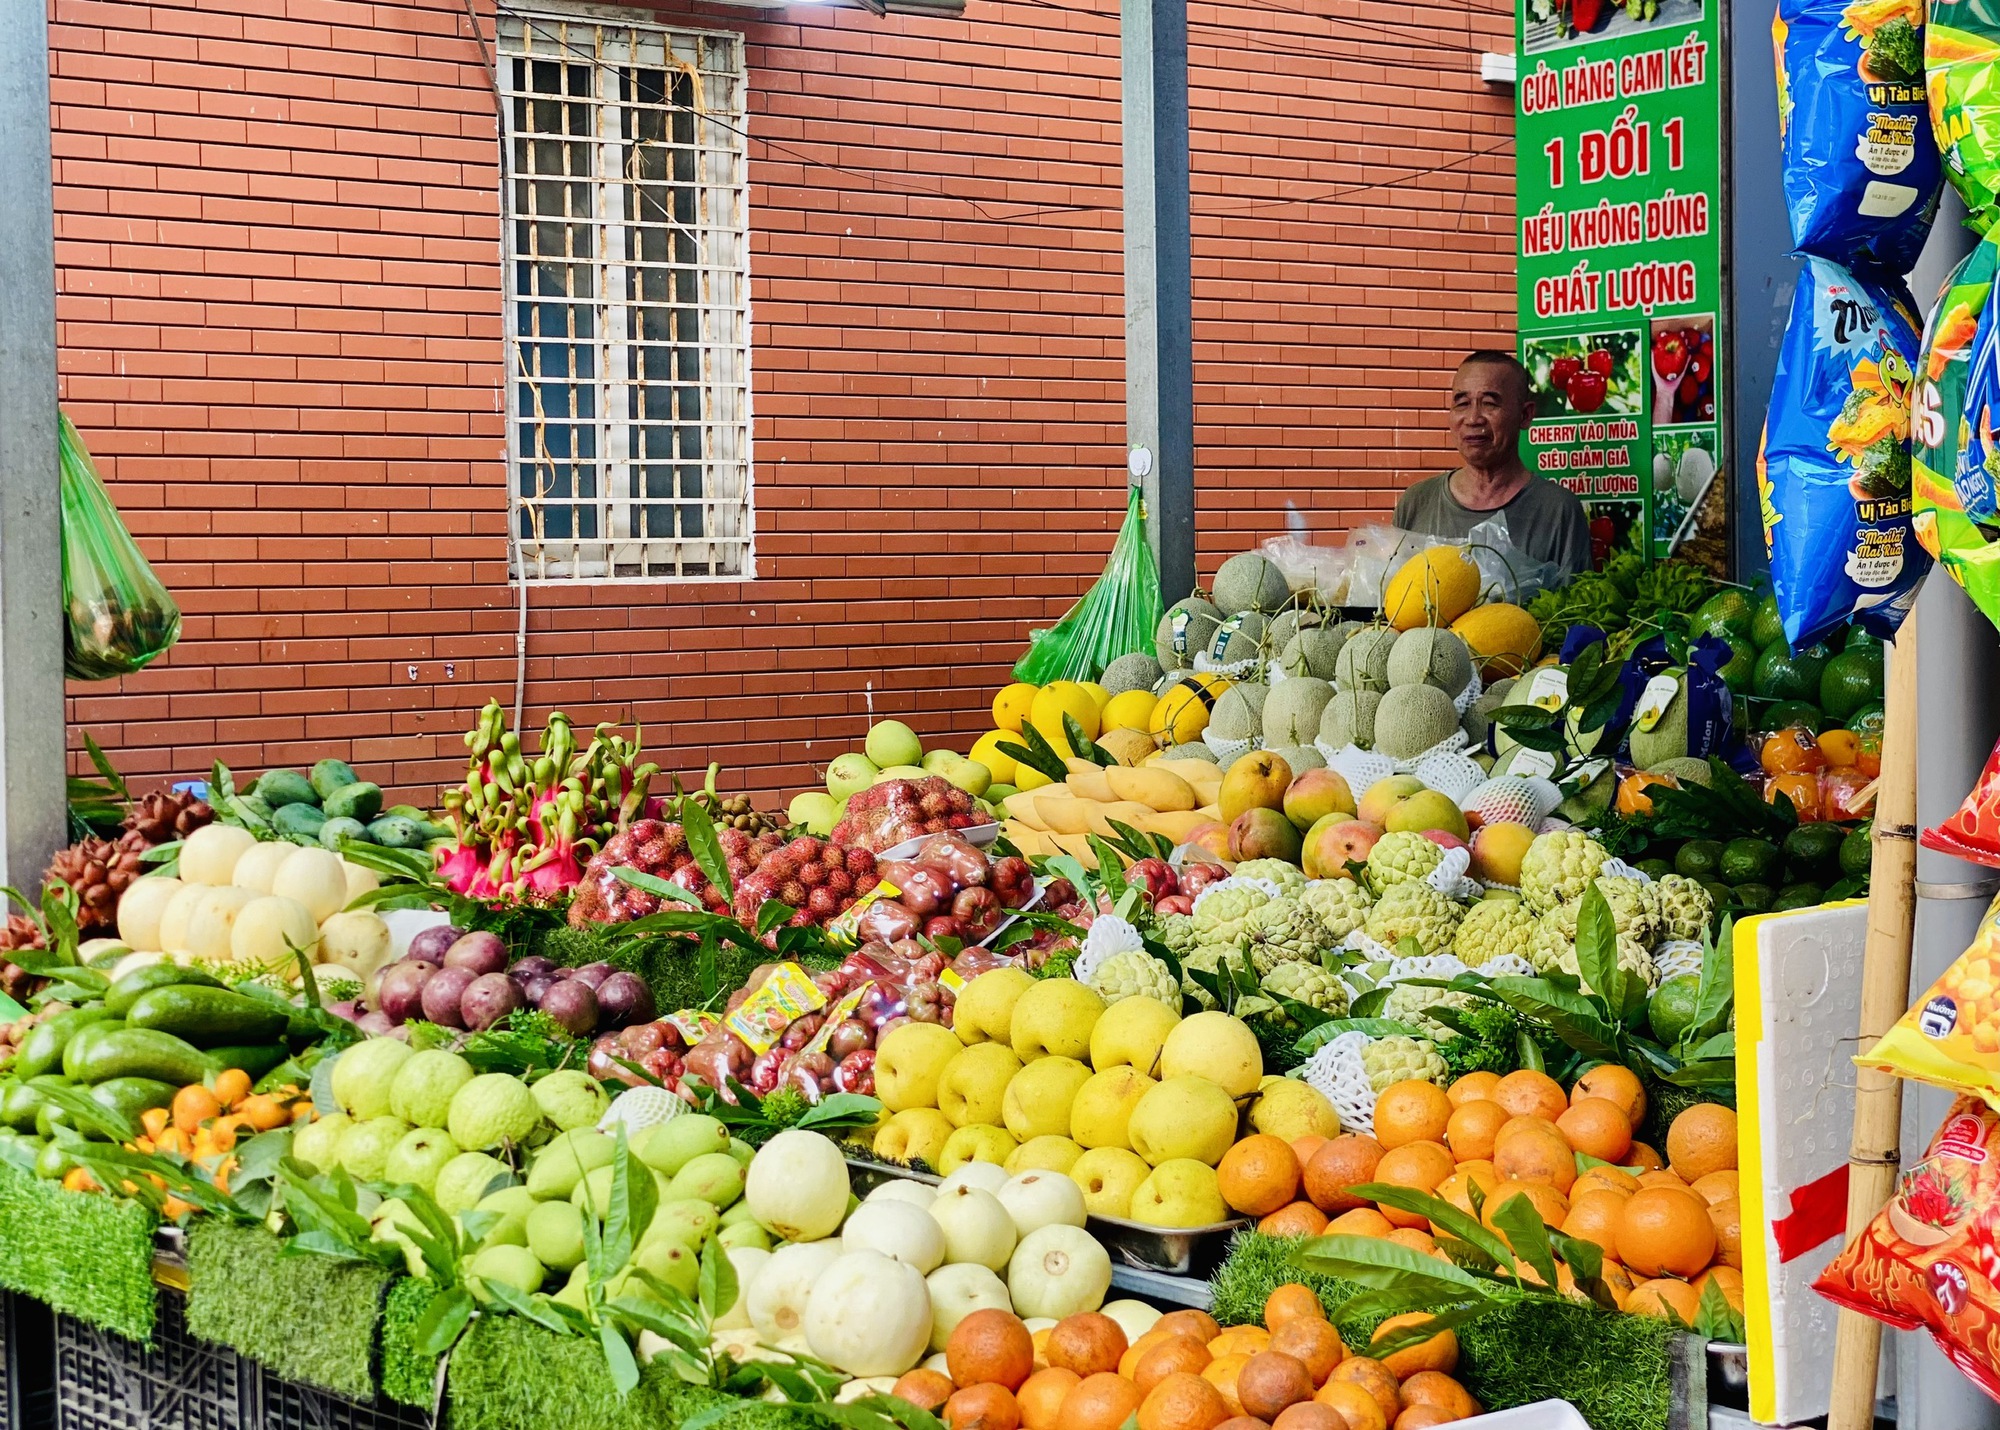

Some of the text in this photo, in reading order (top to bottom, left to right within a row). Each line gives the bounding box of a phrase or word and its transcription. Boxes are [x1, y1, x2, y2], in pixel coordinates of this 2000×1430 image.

[1524, 32, 1706, 113] CỬA HÀNG CAM KẾT
[1869, 87, 1885, 105] Vị
[1889, 86, 1910, 101] Tảo
[1546, 106, 1682, 186] 1 ĐỔI 1
[1868, 130, 1892, 145] Mai
[1524, 190, 1707, 255] NẾU KHÔNG ĐÚNG
[1537, 262, 1694, 315] CHẤT LƯỢNG
[1530, 419, 1638, 443] CHERRY VÀO MÙA
[1539, 446, 1629, 468] SIÊU GIẢM GIÁ
[1596, 476, 1637, 497] LƯỢNG
[1860, 503, 1874, 521] Vị
[1878, 500, 1898, 516] Tảo
[1857, 545, 1881, 558] Mai
[1700, 720, 1713, 757] Melon
[1926, 1000, 1956, 1019] Nướng
[1935, 1263, 1967, 1290] RANG
